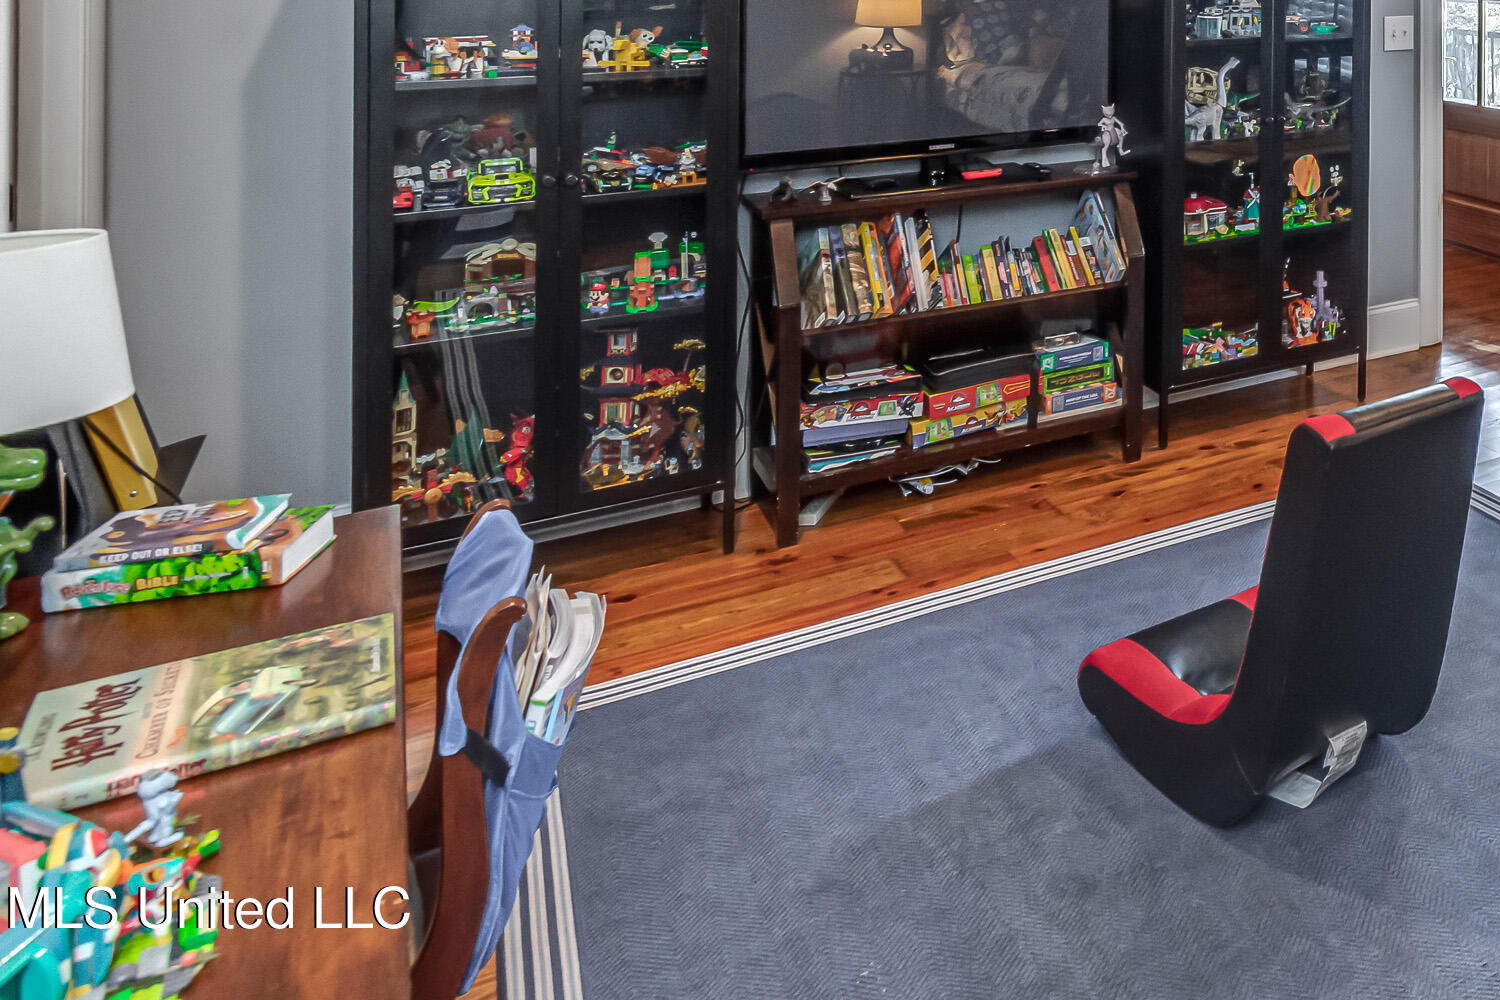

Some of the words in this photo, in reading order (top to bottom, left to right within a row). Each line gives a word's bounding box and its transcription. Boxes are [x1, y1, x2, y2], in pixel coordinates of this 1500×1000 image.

[98, 552, 129, 564] KEEP
[131, 549, 152, 560] OUT
[154, 547, 170, 557] OR
[135, 575, 179, 591] BIBLE
[57, 677, 143, 733] Potter
